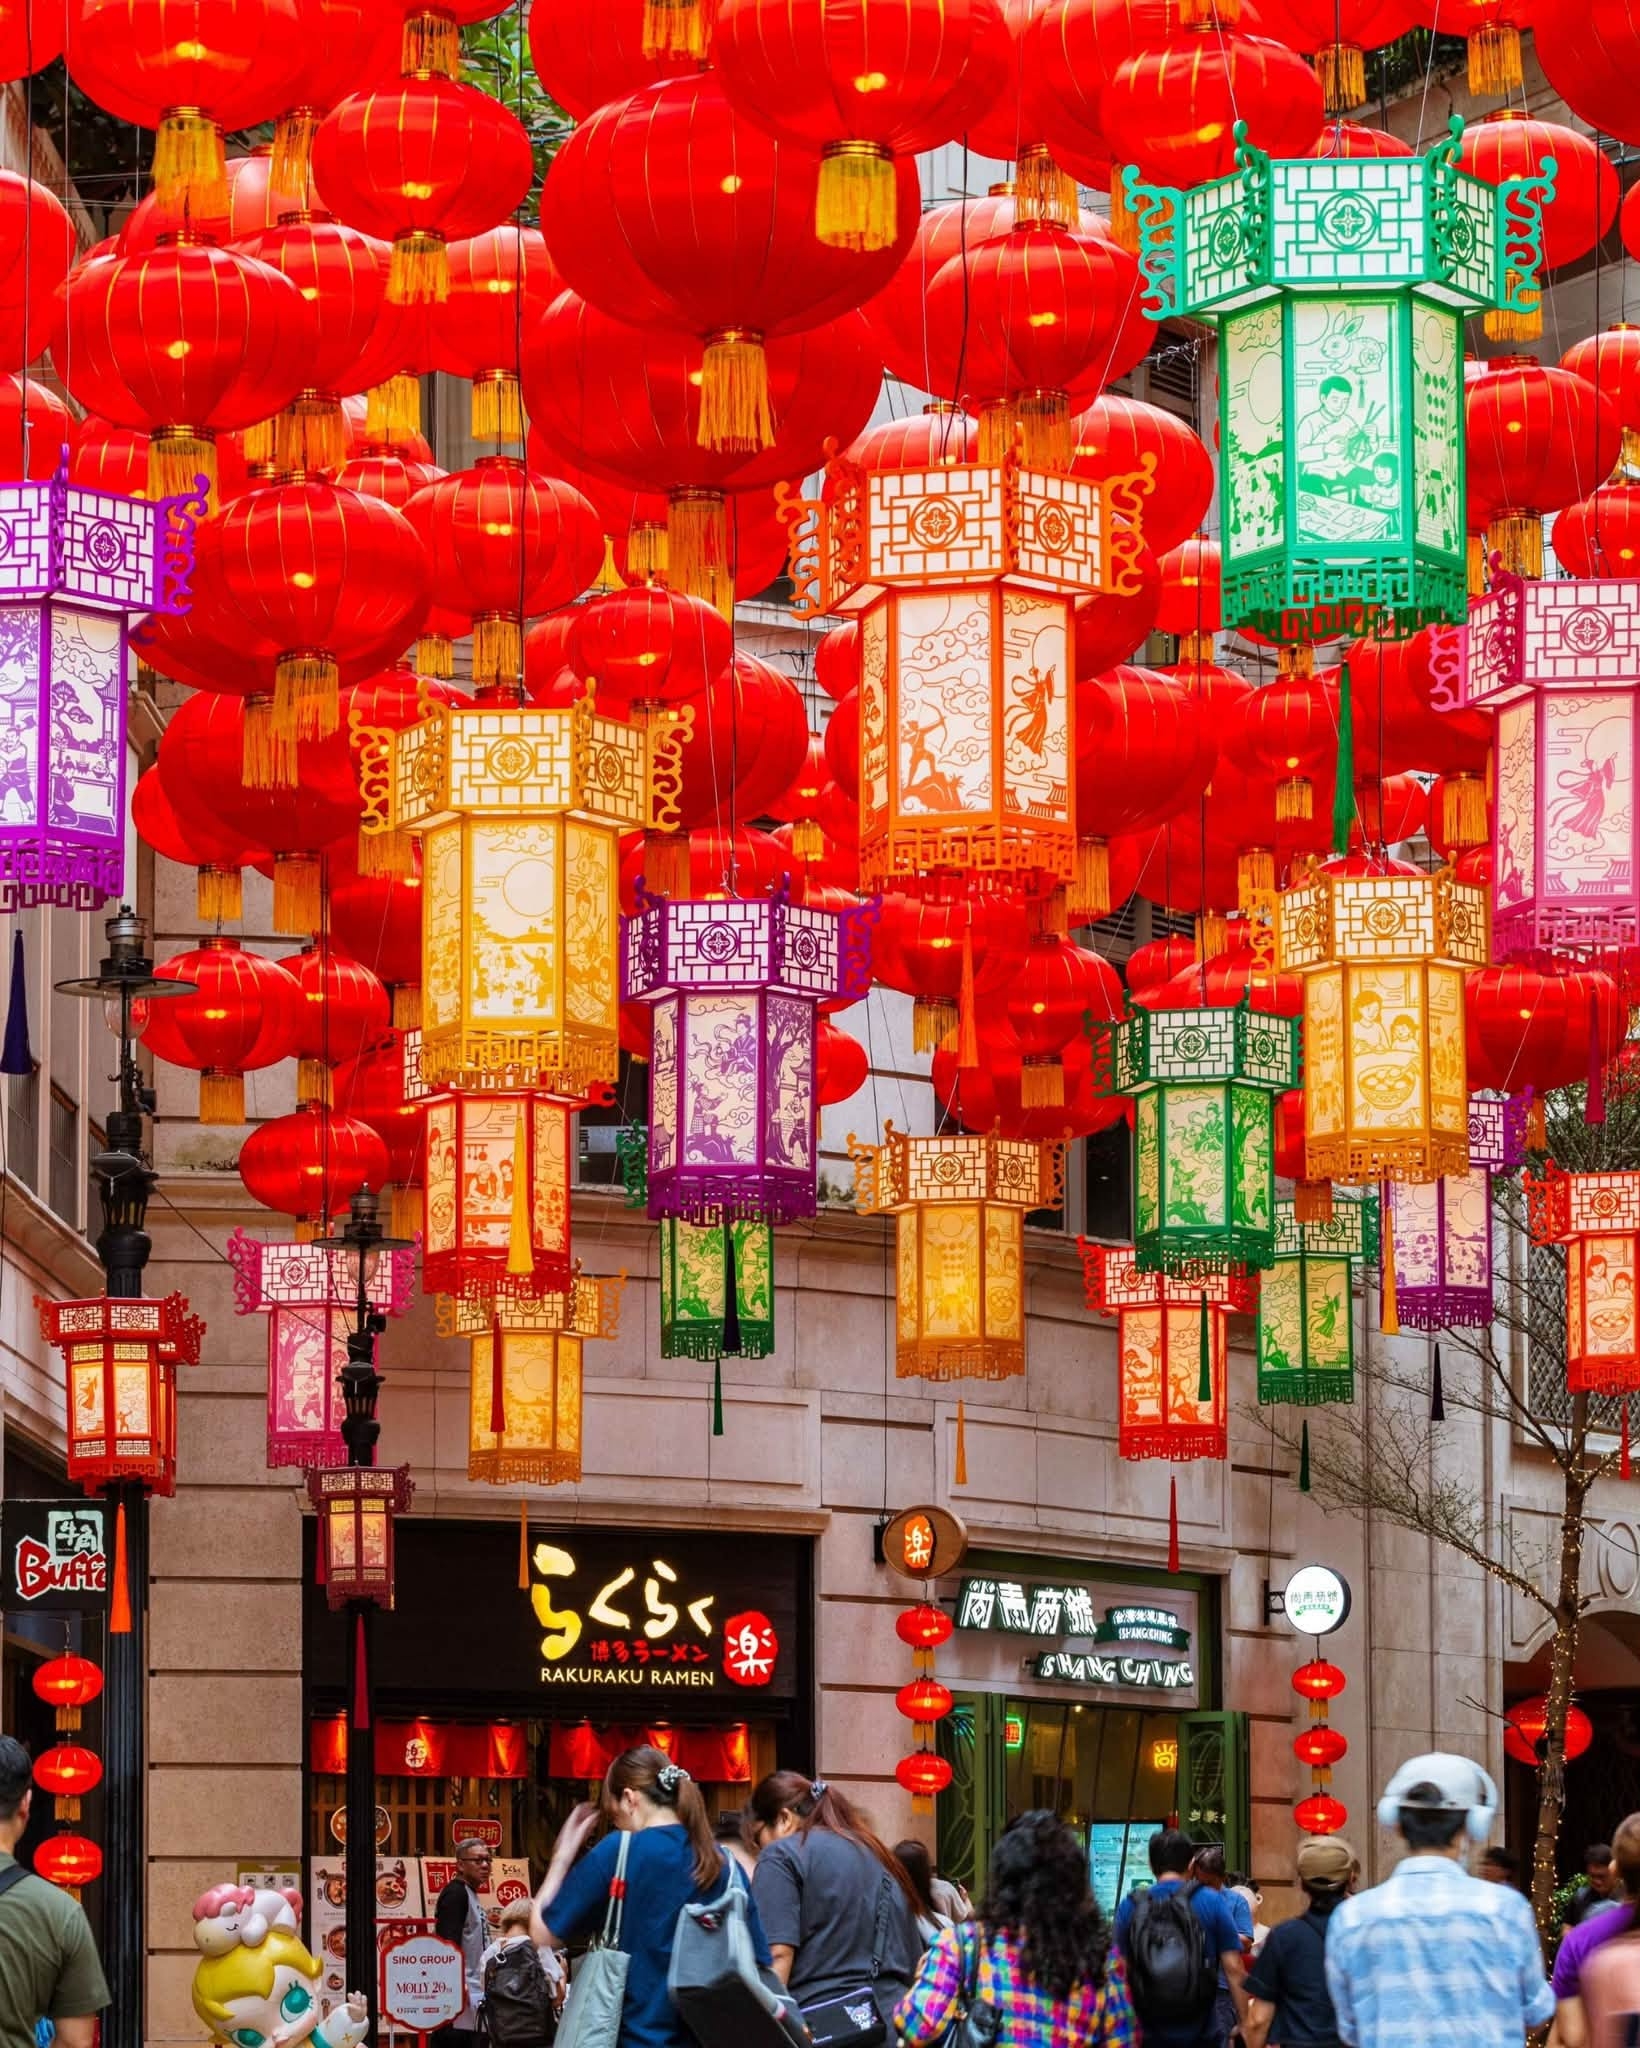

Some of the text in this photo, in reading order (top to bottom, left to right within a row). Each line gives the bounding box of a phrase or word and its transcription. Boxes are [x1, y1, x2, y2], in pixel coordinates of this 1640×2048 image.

[56, 1521, 97, 1552] 牛角
[532, 1544, 714, 1660] らくらく
[590, 1640, 709, 1662] 博多ラーメン
[541, 1668, 714, 1686] RAKURAKU RAMEN
[1041, 1653, 1193, 1687] SHANG CHING
[479, 1826, 498, 1840] 9折
[392, 1955, 456, 1965] SINO GROUP
[396, 1982, 429, 1994] MOLLY
